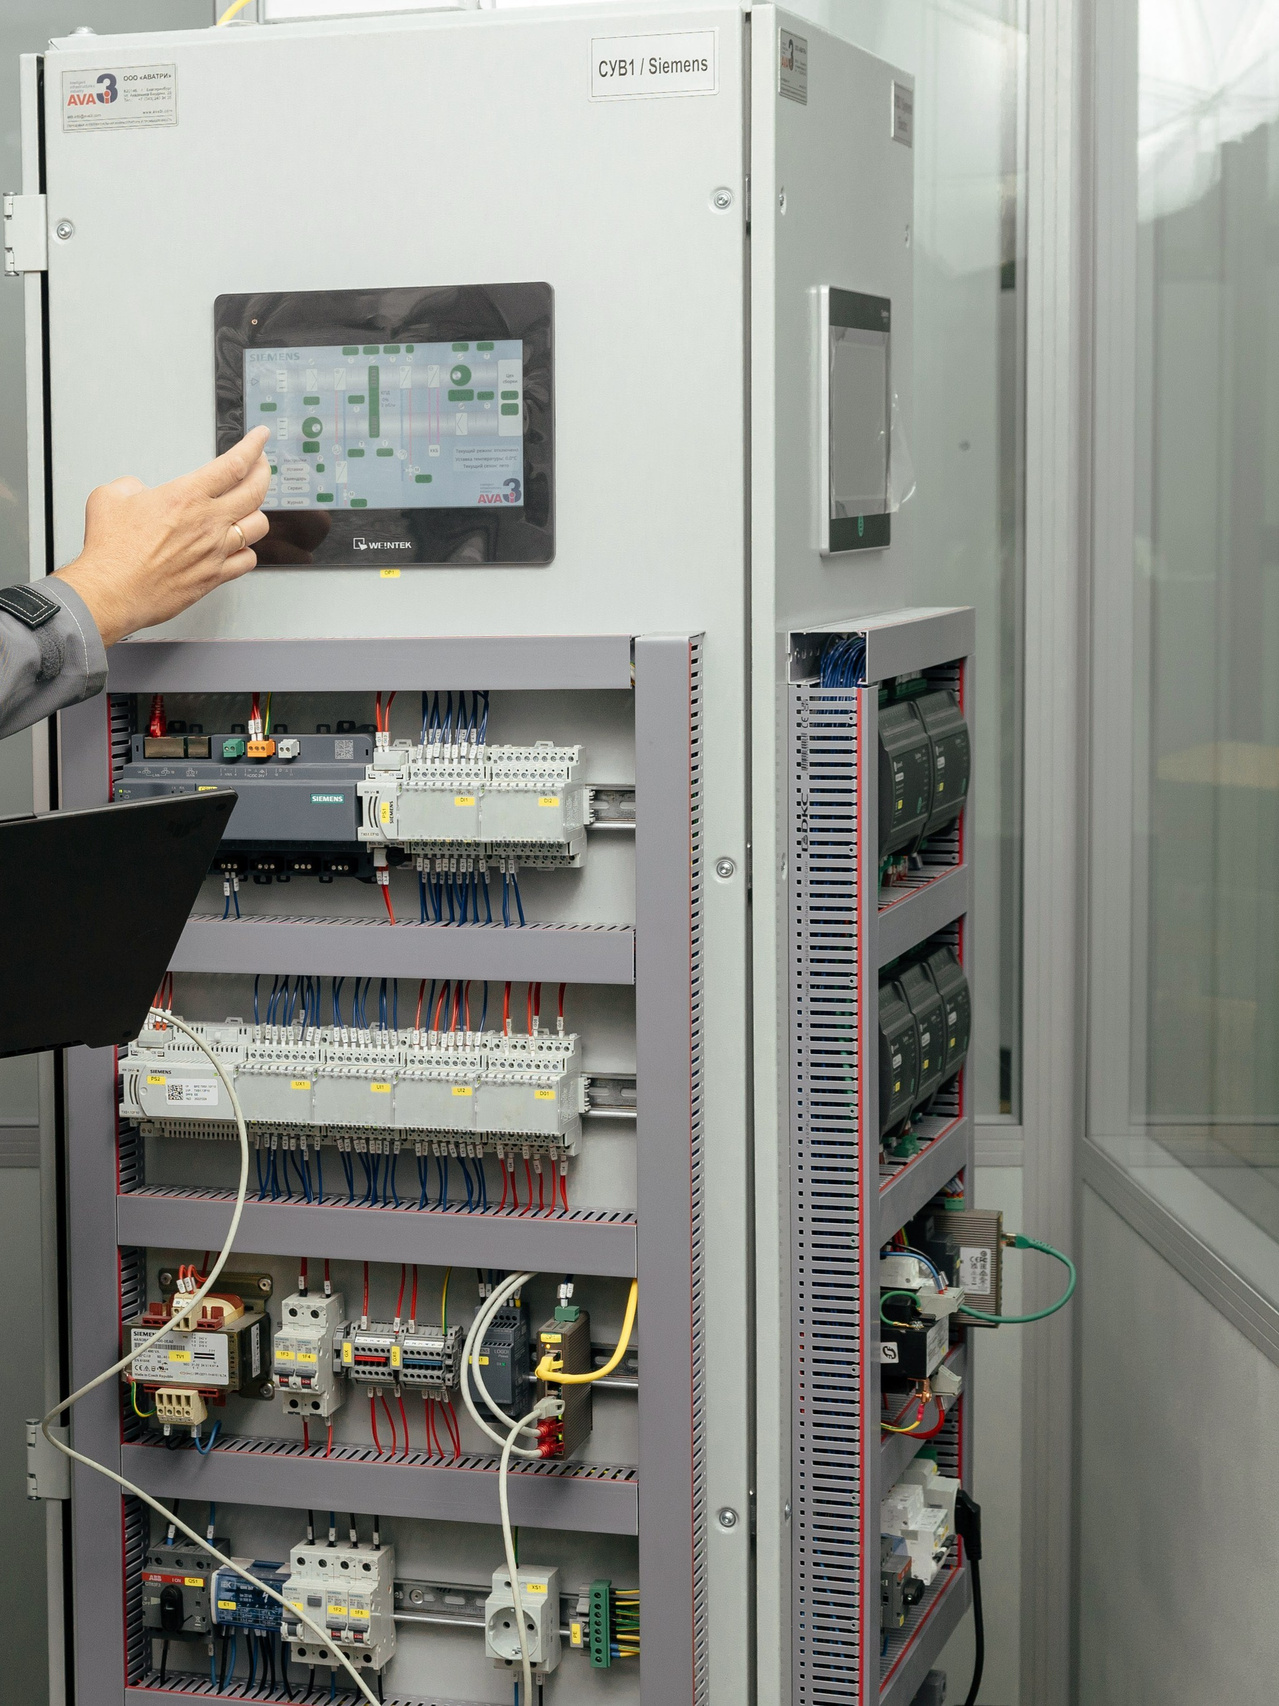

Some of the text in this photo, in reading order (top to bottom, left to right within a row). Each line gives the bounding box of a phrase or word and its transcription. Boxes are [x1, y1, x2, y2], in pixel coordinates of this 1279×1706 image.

[648, 57, 709, 75] Siemens
[123, 74, 138, 82] ООО
[249, 352, 300, 362] SIEMENS
[311, 795, 344, 803] SIEMENS
[148, 1574, 162, 1582] ABB
